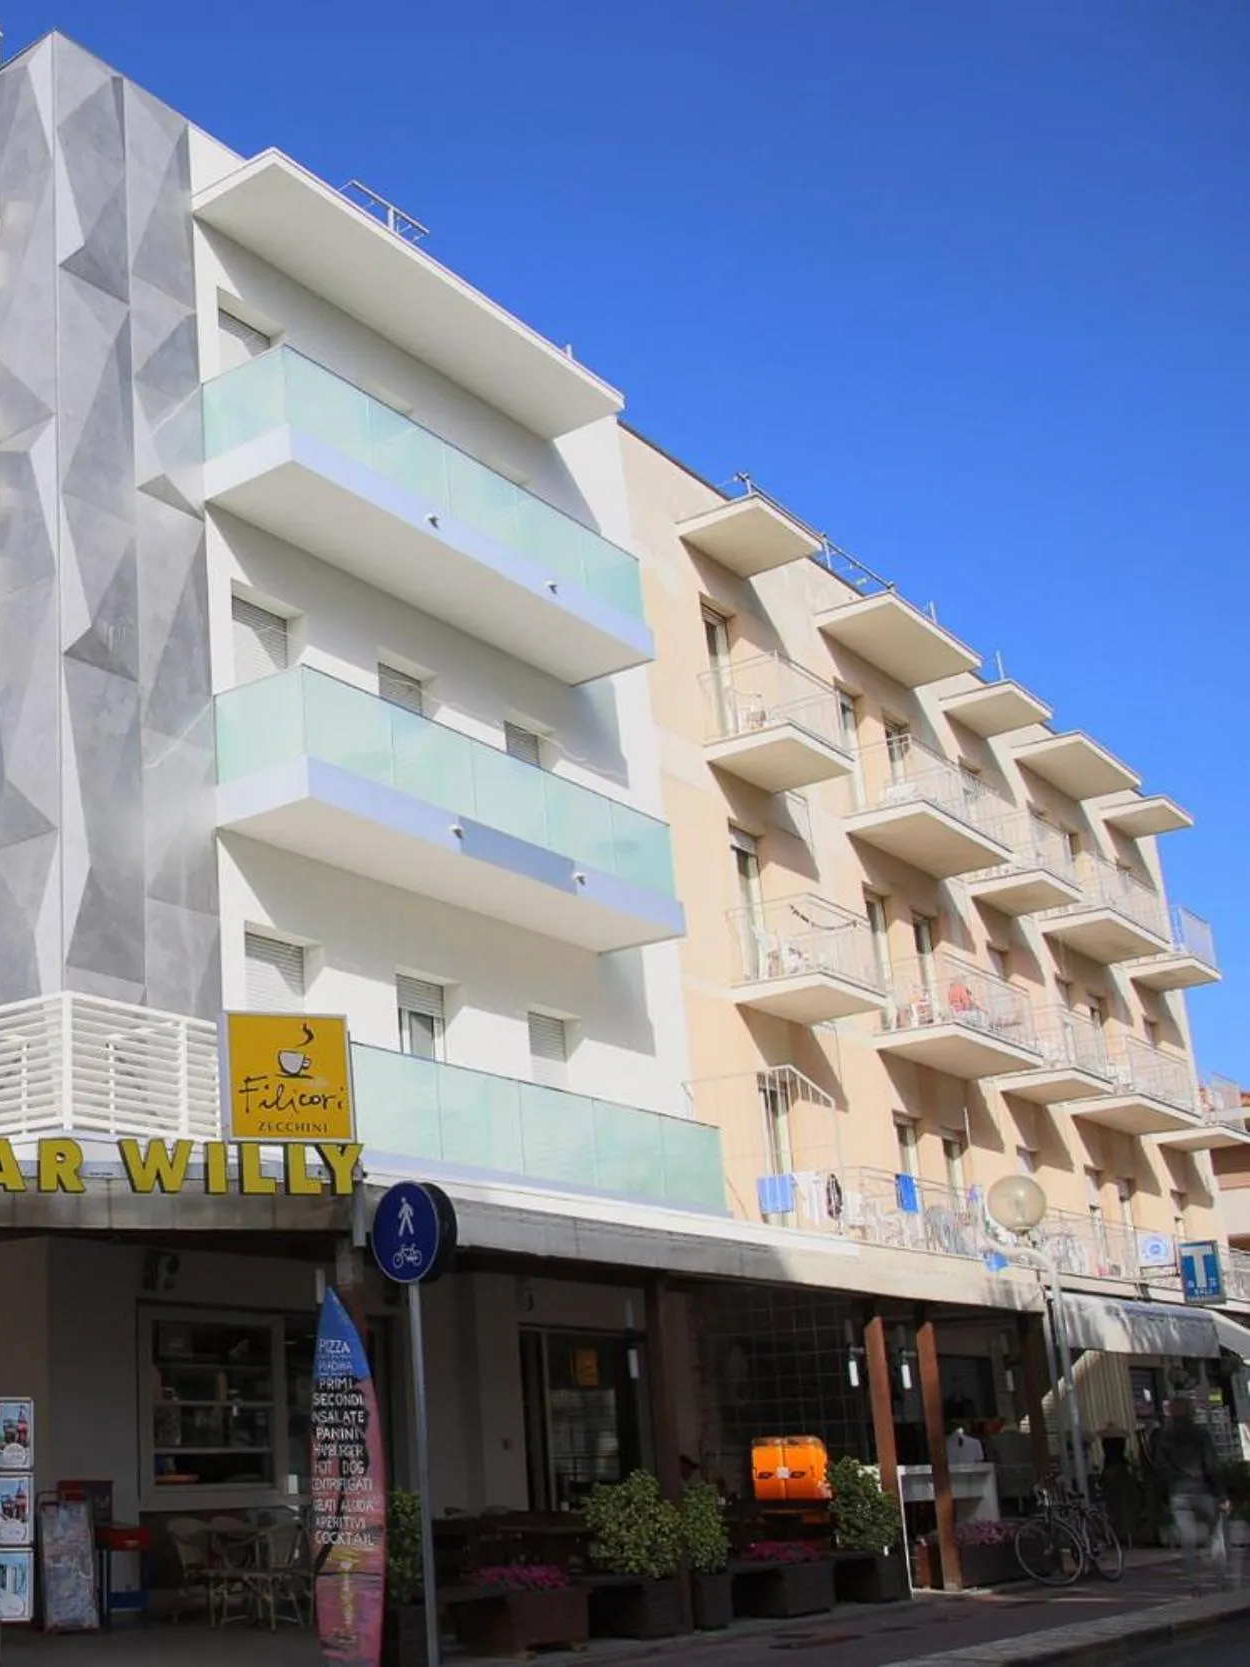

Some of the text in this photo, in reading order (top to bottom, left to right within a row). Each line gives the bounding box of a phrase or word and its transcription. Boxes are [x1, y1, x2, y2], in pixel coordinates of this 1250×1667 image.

[238, 1075, 344, 1114] Filicori
[258, 1120, 328, 1133] ZECCHINI
[117, 1138, 364, 1195] WILLY
[1181, 1246, 1213, 1288] T
[319, 1339, 351, 1354] PIZZA
[319, 1377, 353, 1391] PRIMI
[312, 1392, 364, 1406] SECONDI
[311, 1410, 366, 1425] NSALATE
[316, 1427, 360, 1441] PANINI
[314, 1459, 365, 1475] HOT DOG
[315, 1530, 375, 1546] COCKTAIL
